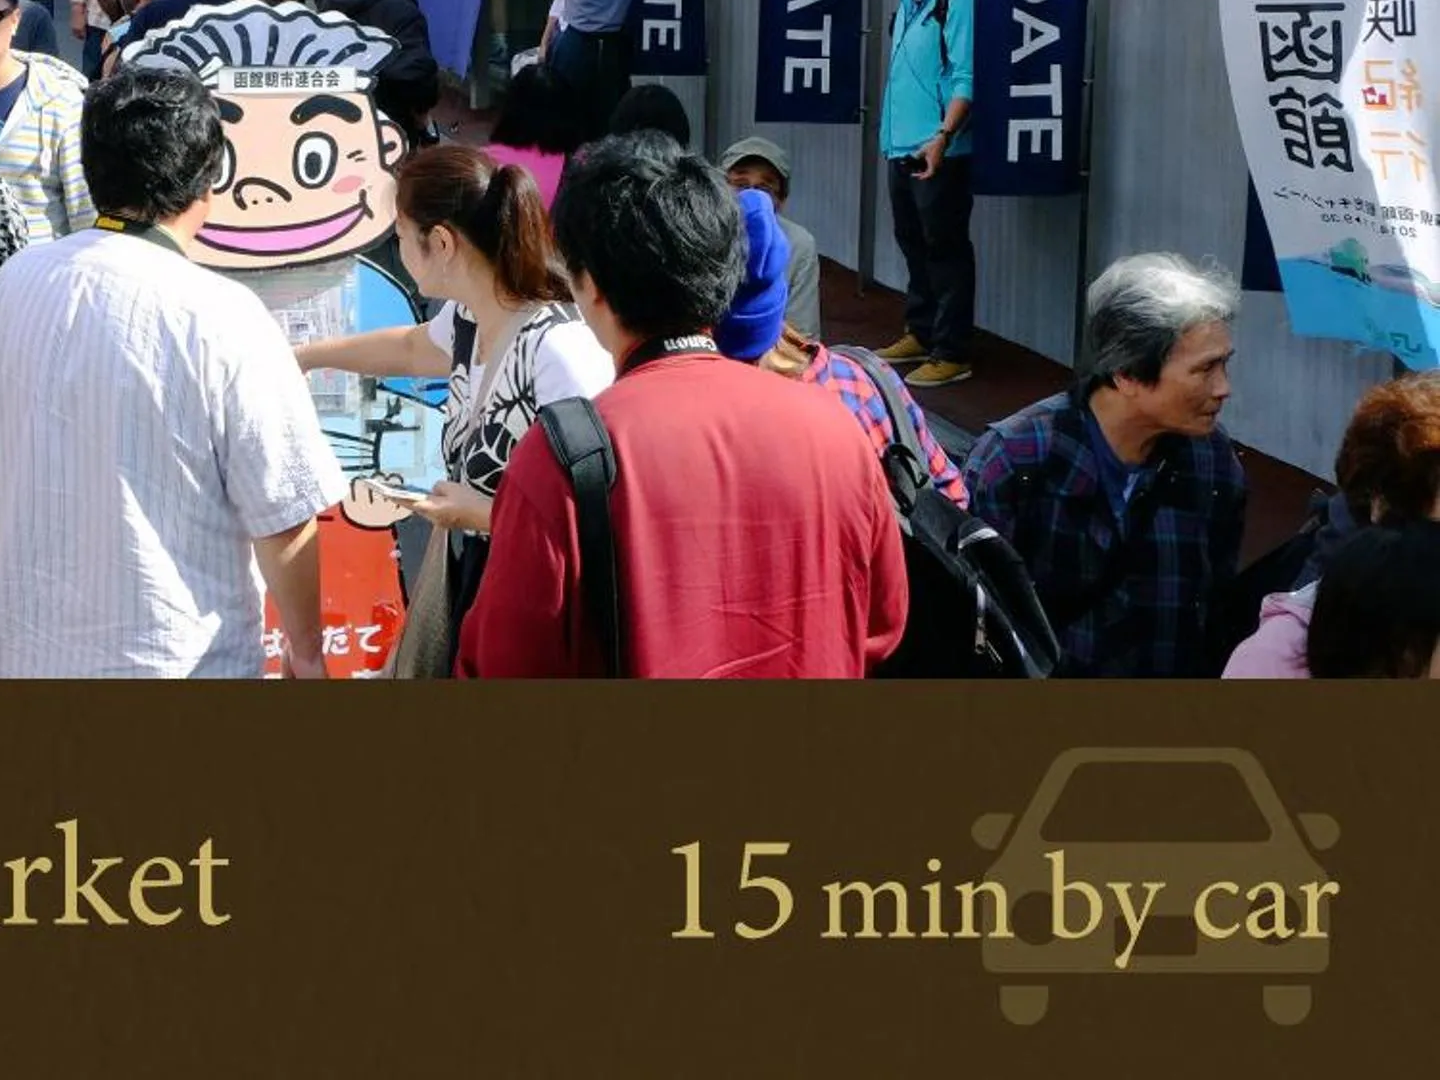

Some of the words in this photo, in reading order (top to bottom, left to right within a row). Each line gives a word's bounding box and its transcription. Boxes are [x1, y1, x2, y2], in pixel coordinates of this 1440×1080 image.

[233, 70, 341, 89] 函館朝市連合会
[663, 335, 718, 352] Canon
[260, 622, 383, 656] はだて
